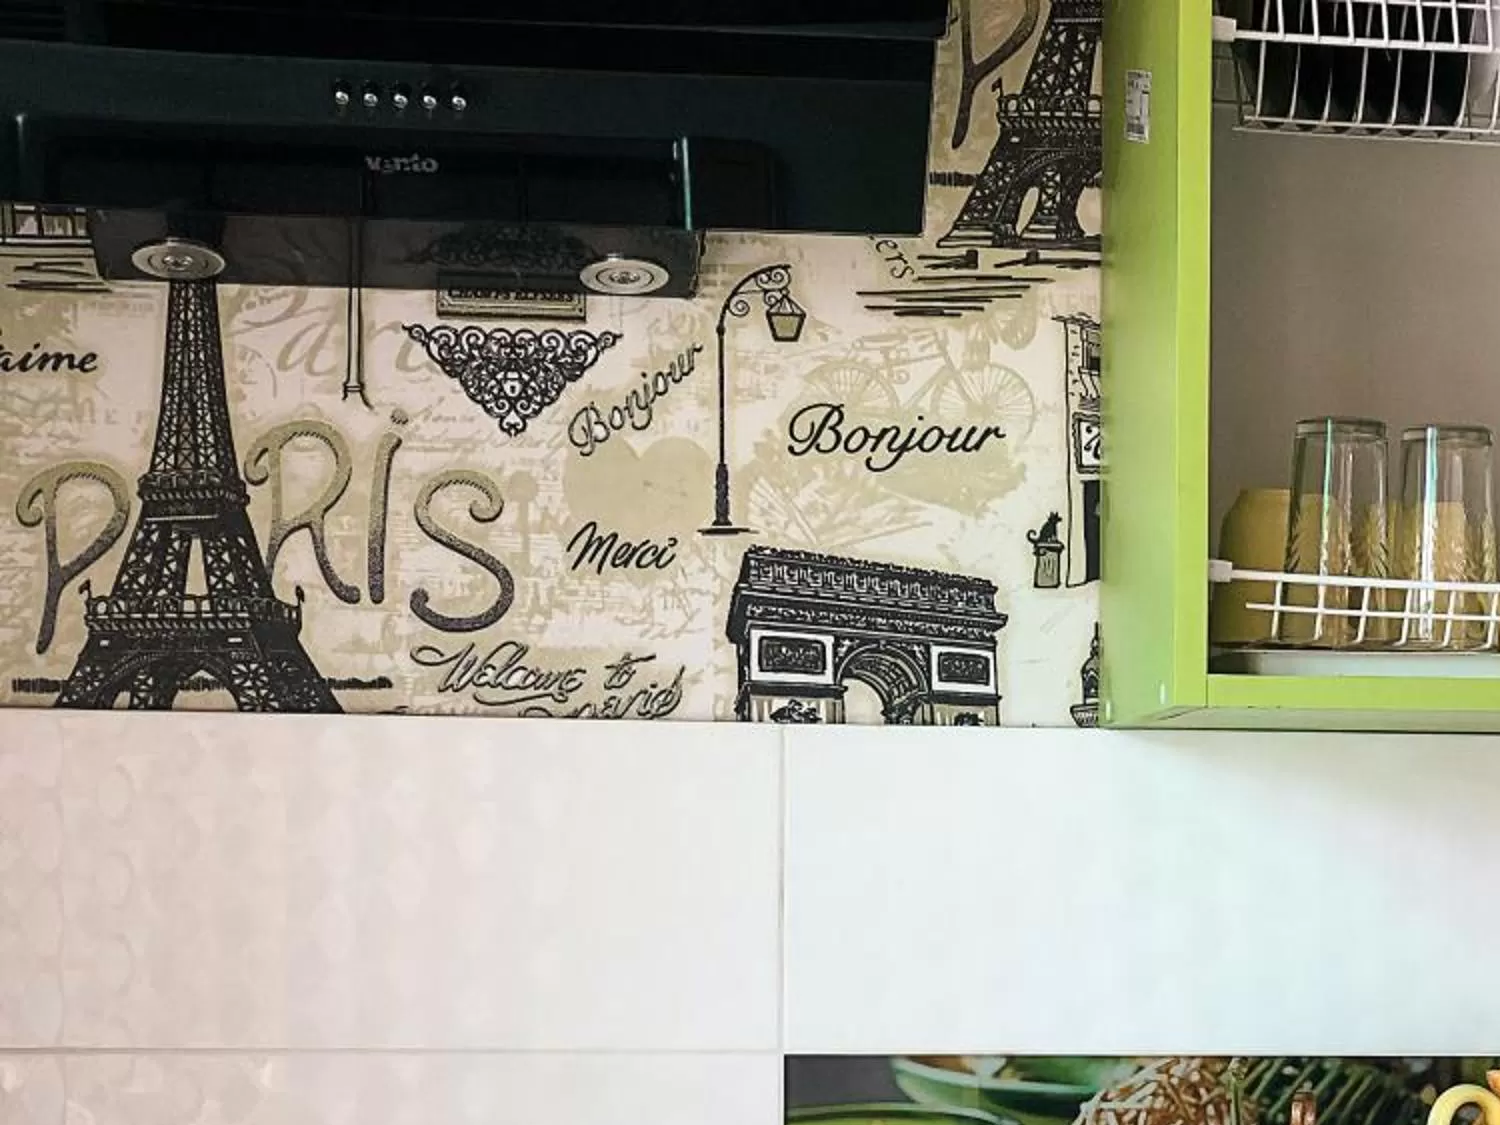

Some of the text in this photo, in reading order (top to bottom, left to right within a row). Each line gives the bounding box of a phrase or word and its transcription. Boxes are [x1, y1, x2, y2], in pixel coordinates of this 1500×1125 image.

[568, 344, 704, 457] Bonjour
[787, 402, 1006, 472] Bonjour
[566, 521, 679, 575] Merci
[410, 641, 657, 706] Welcome to
